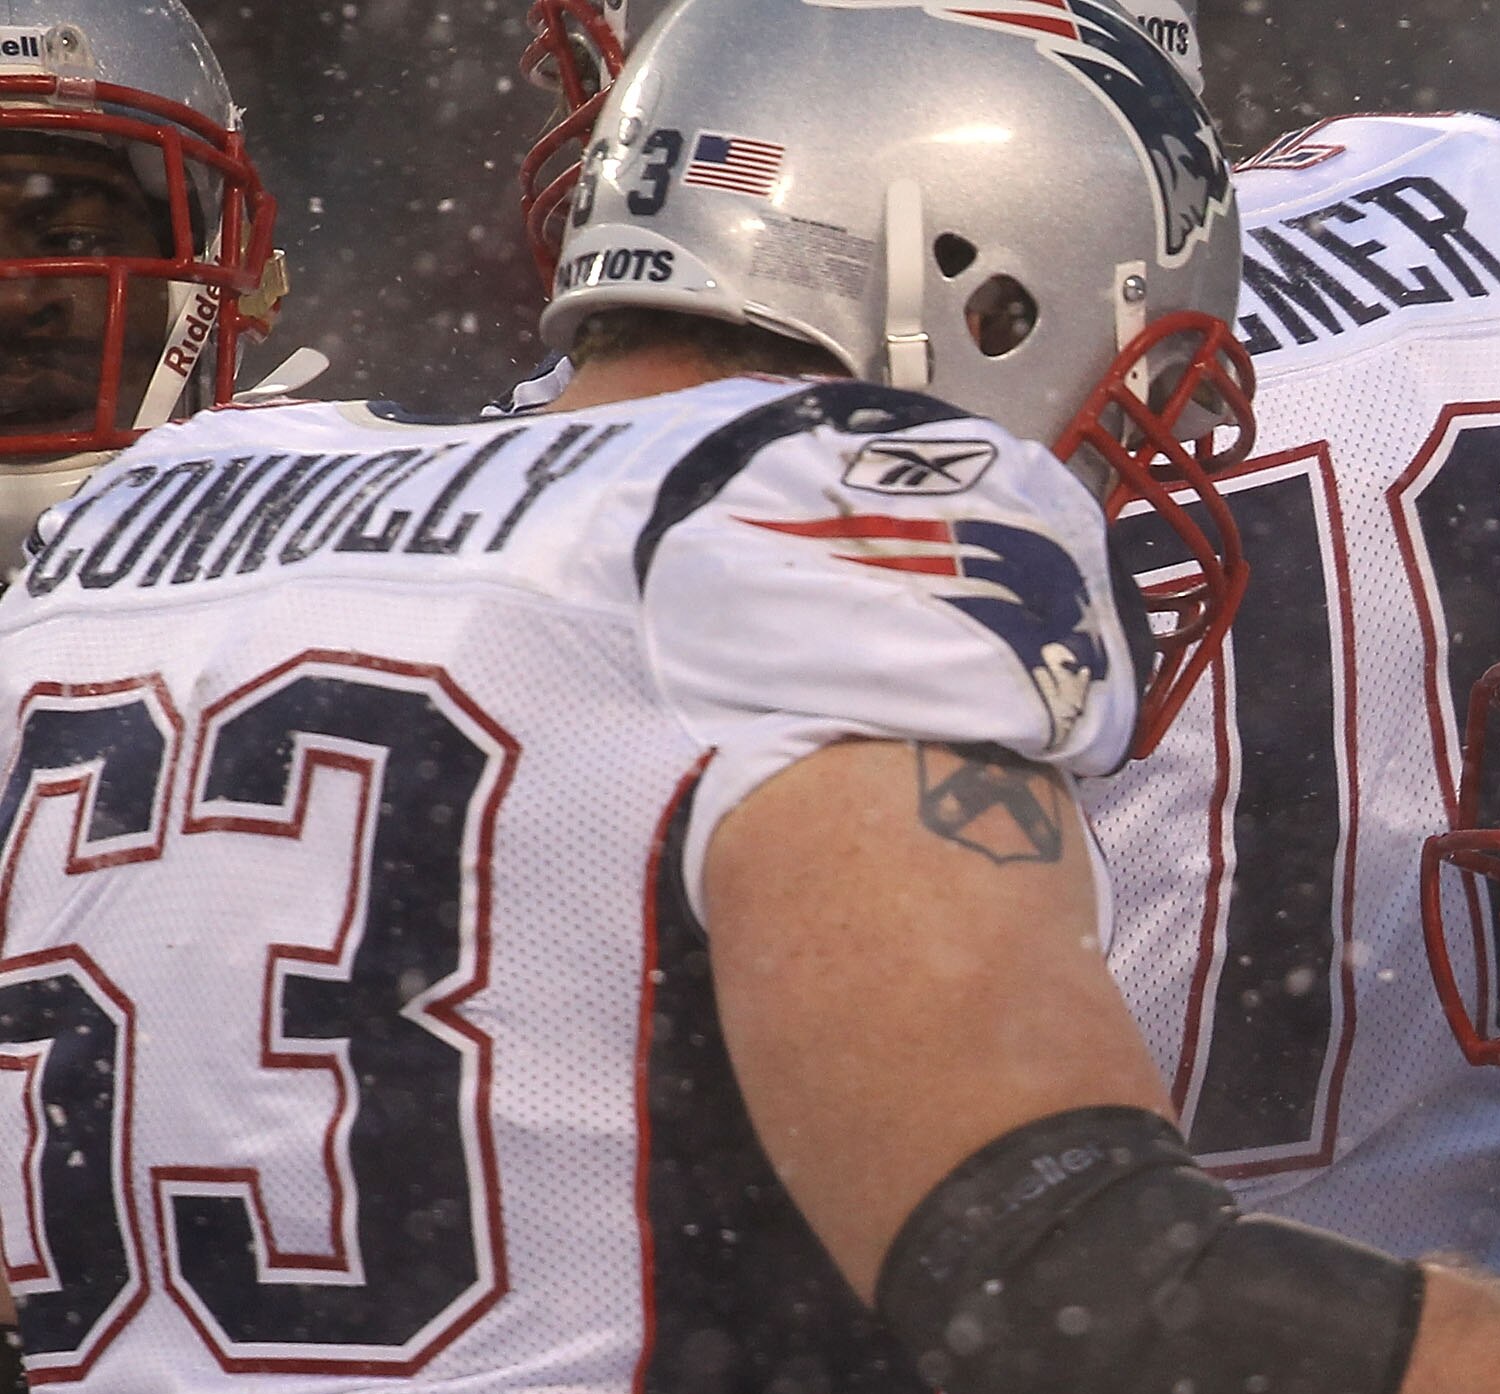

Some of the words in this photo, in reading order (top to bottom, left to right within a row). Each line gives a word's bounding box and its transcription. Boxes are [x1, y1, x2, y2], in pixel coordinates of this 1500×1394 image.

[0, 36, 39, 57] ell
[1137, 16, 1189, 55] OTS
[26, 422, 633, 597] CONNOLLY
[0, 647, 523, 1387] 63
